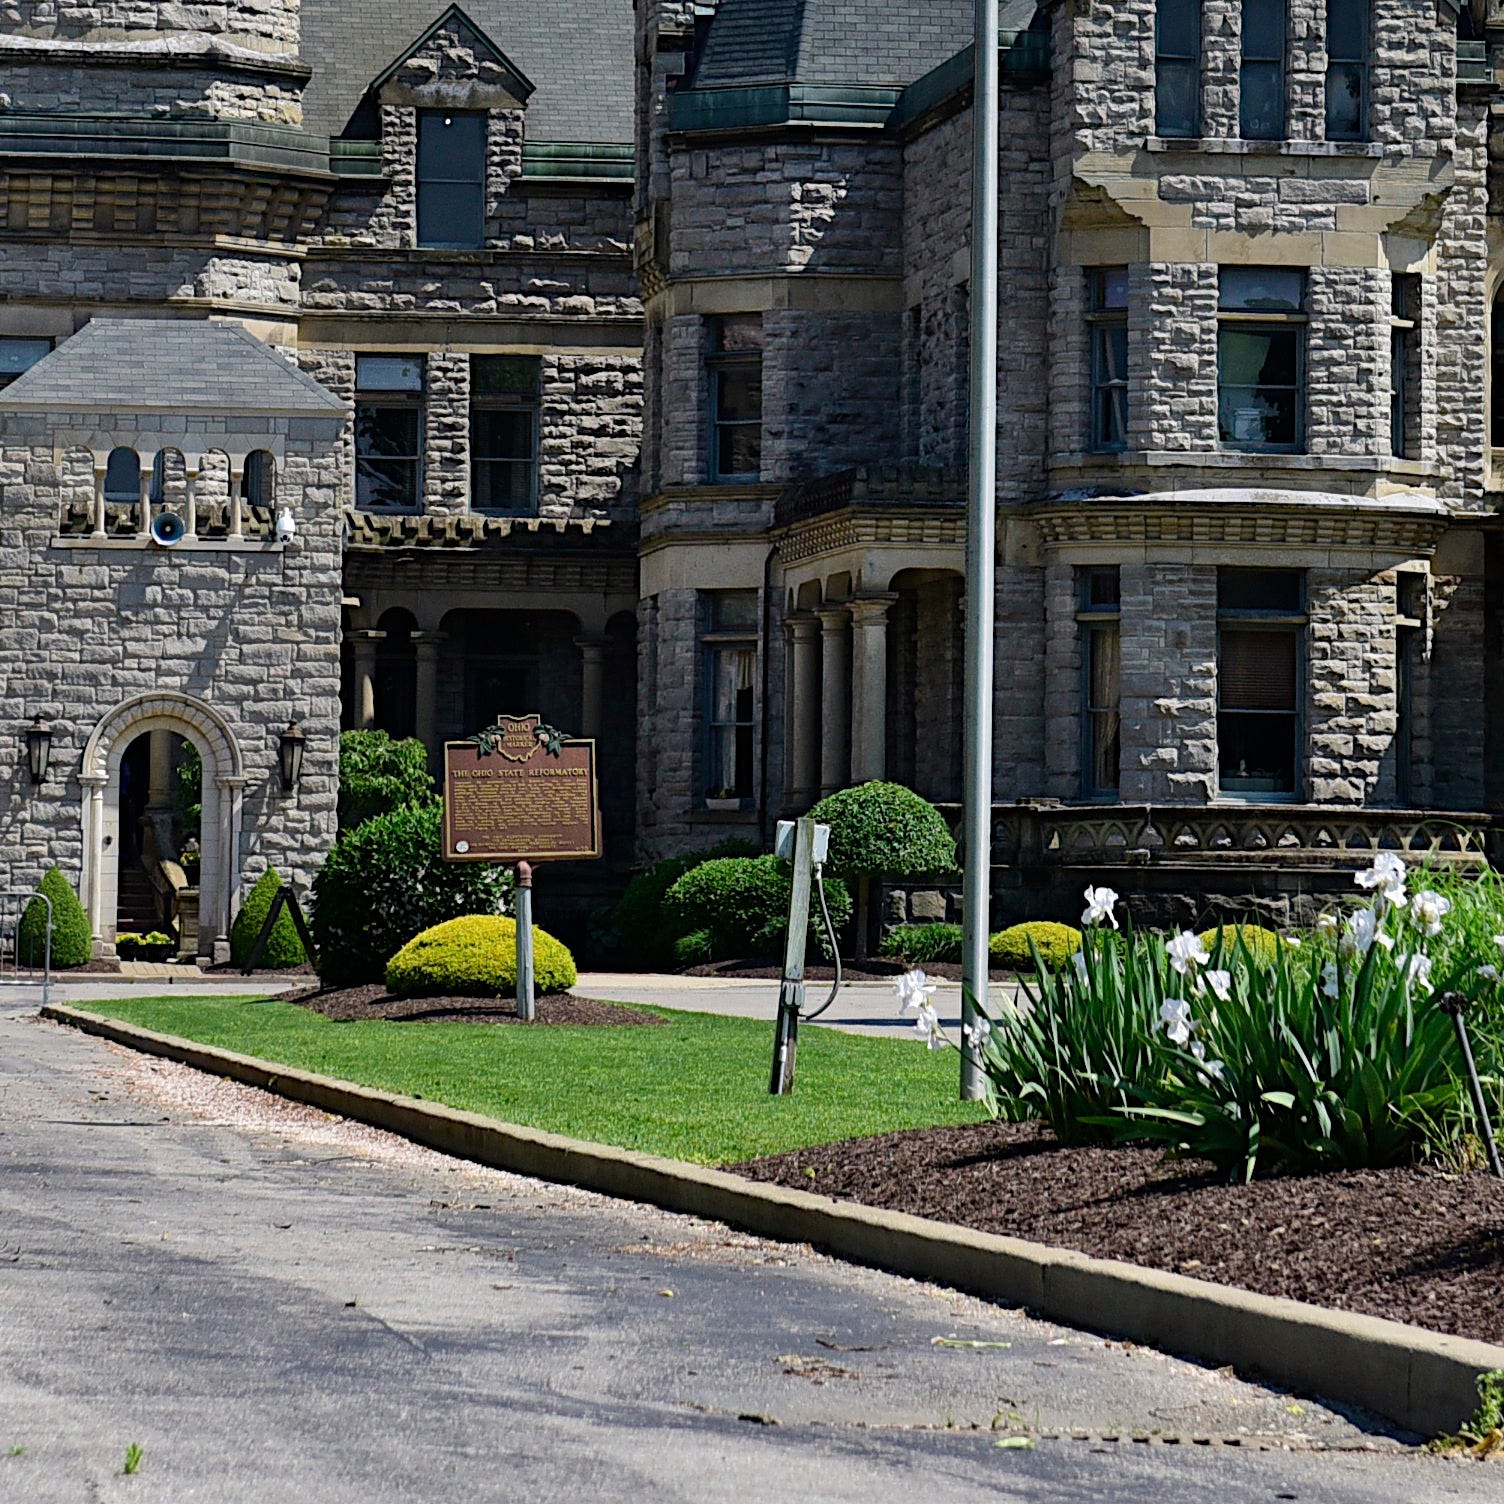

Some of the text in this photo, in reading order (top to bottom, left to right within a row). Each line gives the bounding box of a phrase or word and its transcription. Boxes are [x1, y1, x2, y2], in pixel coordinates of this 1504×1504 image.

[507, 723, 531, 733] OHIO
[452, 767, 589, 778] THE OHIO STATE REFORMATORY
